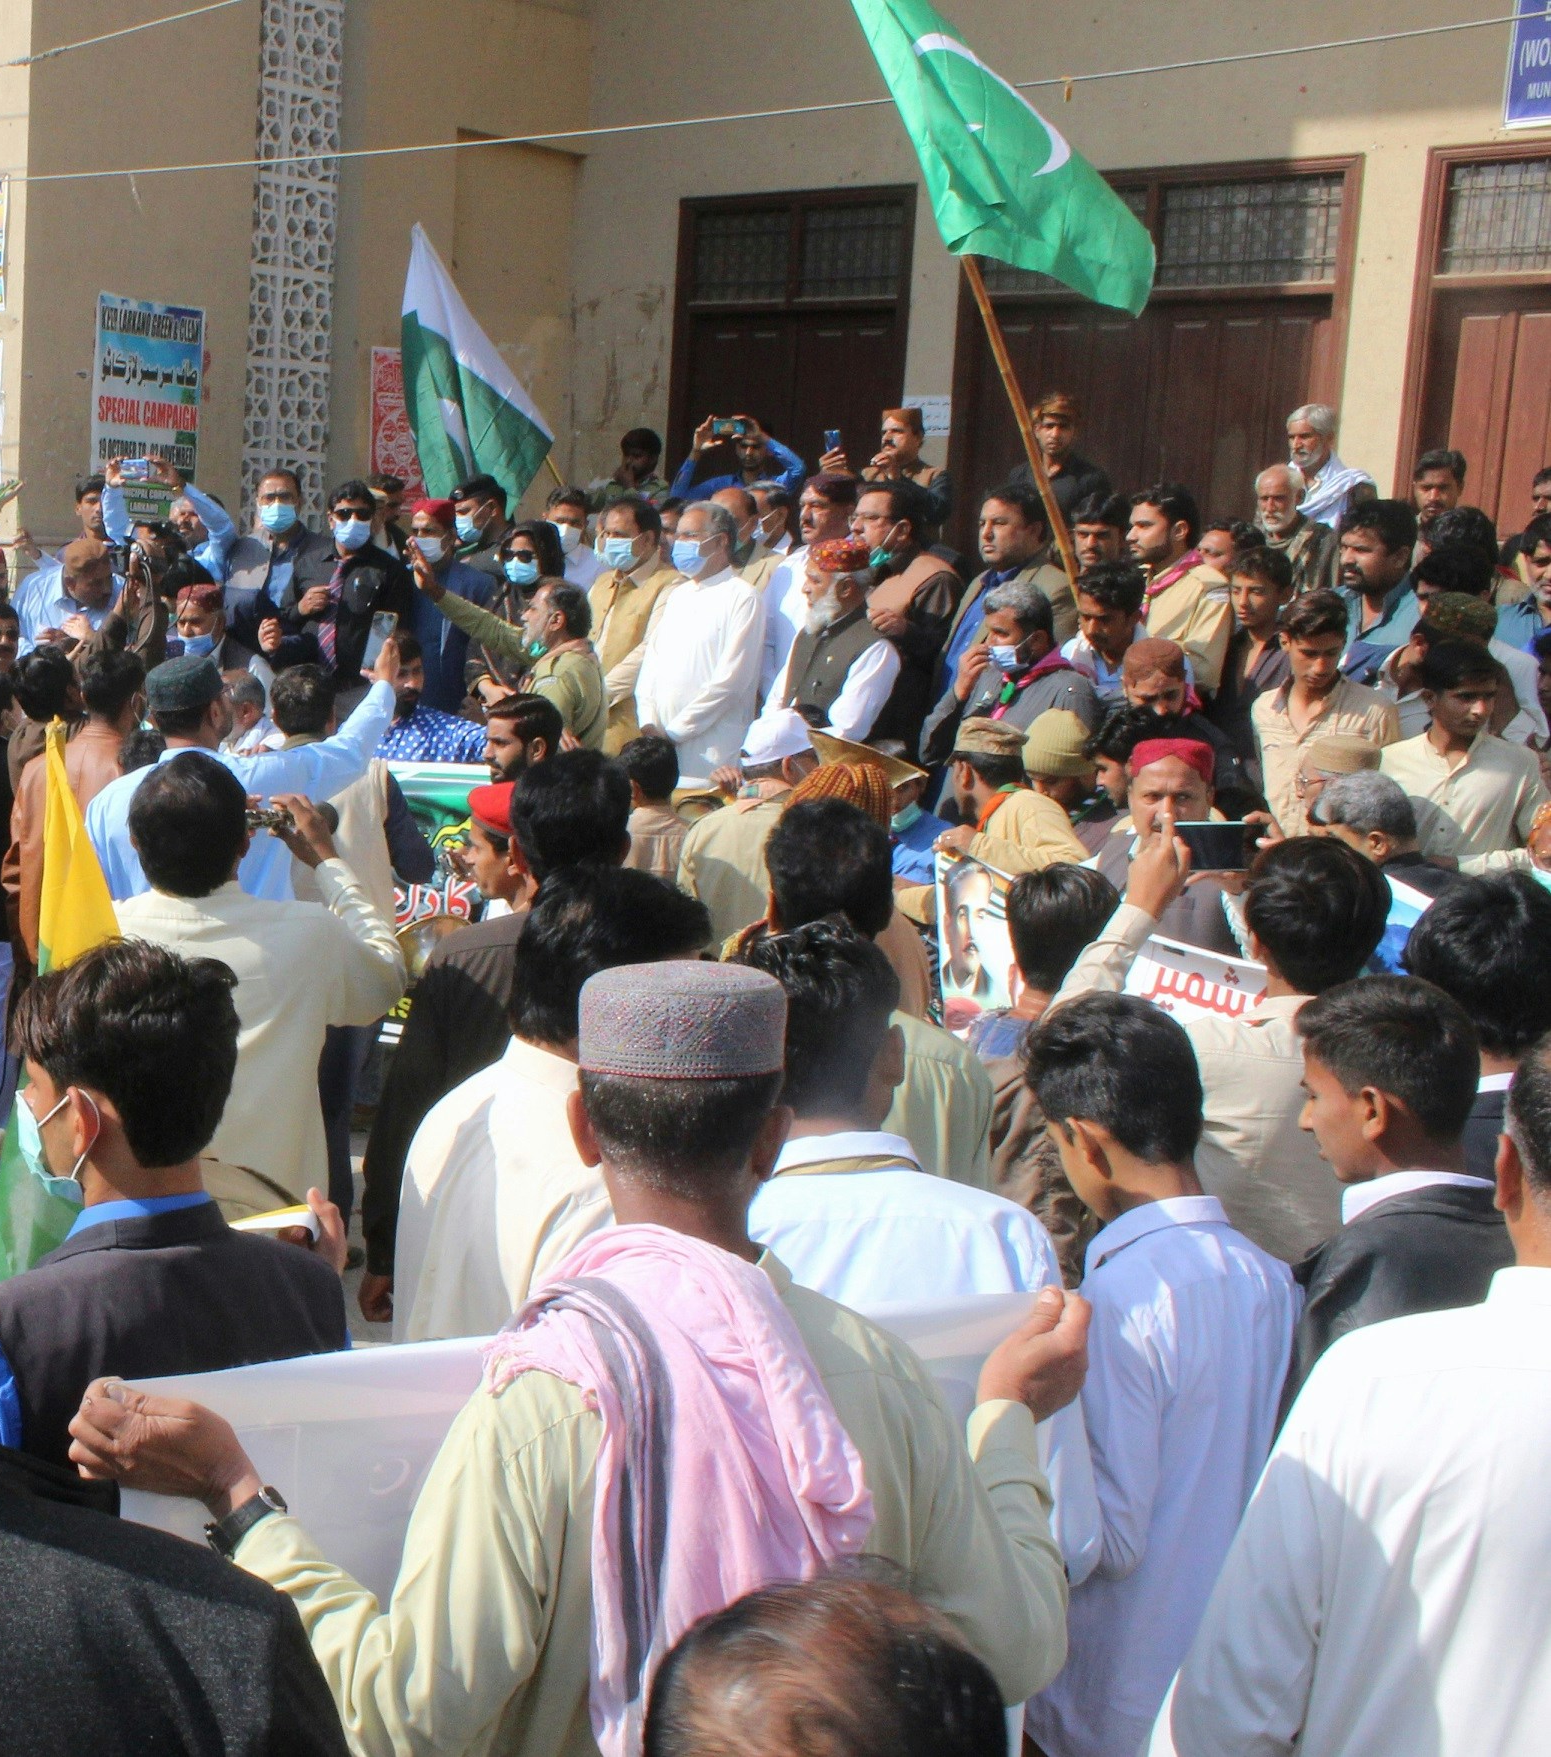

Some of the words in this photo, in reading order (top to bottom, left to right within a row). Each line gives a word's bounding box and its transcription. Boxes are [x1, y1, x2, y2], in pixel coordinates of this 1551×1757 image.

[1519, 37, 1551, 76] (WO
[98, 395, 141, 426] SPECIAL
[143, 401, 197, 431] CAMPAIGN
[1140, 965, 1267, 1018] شمیر
